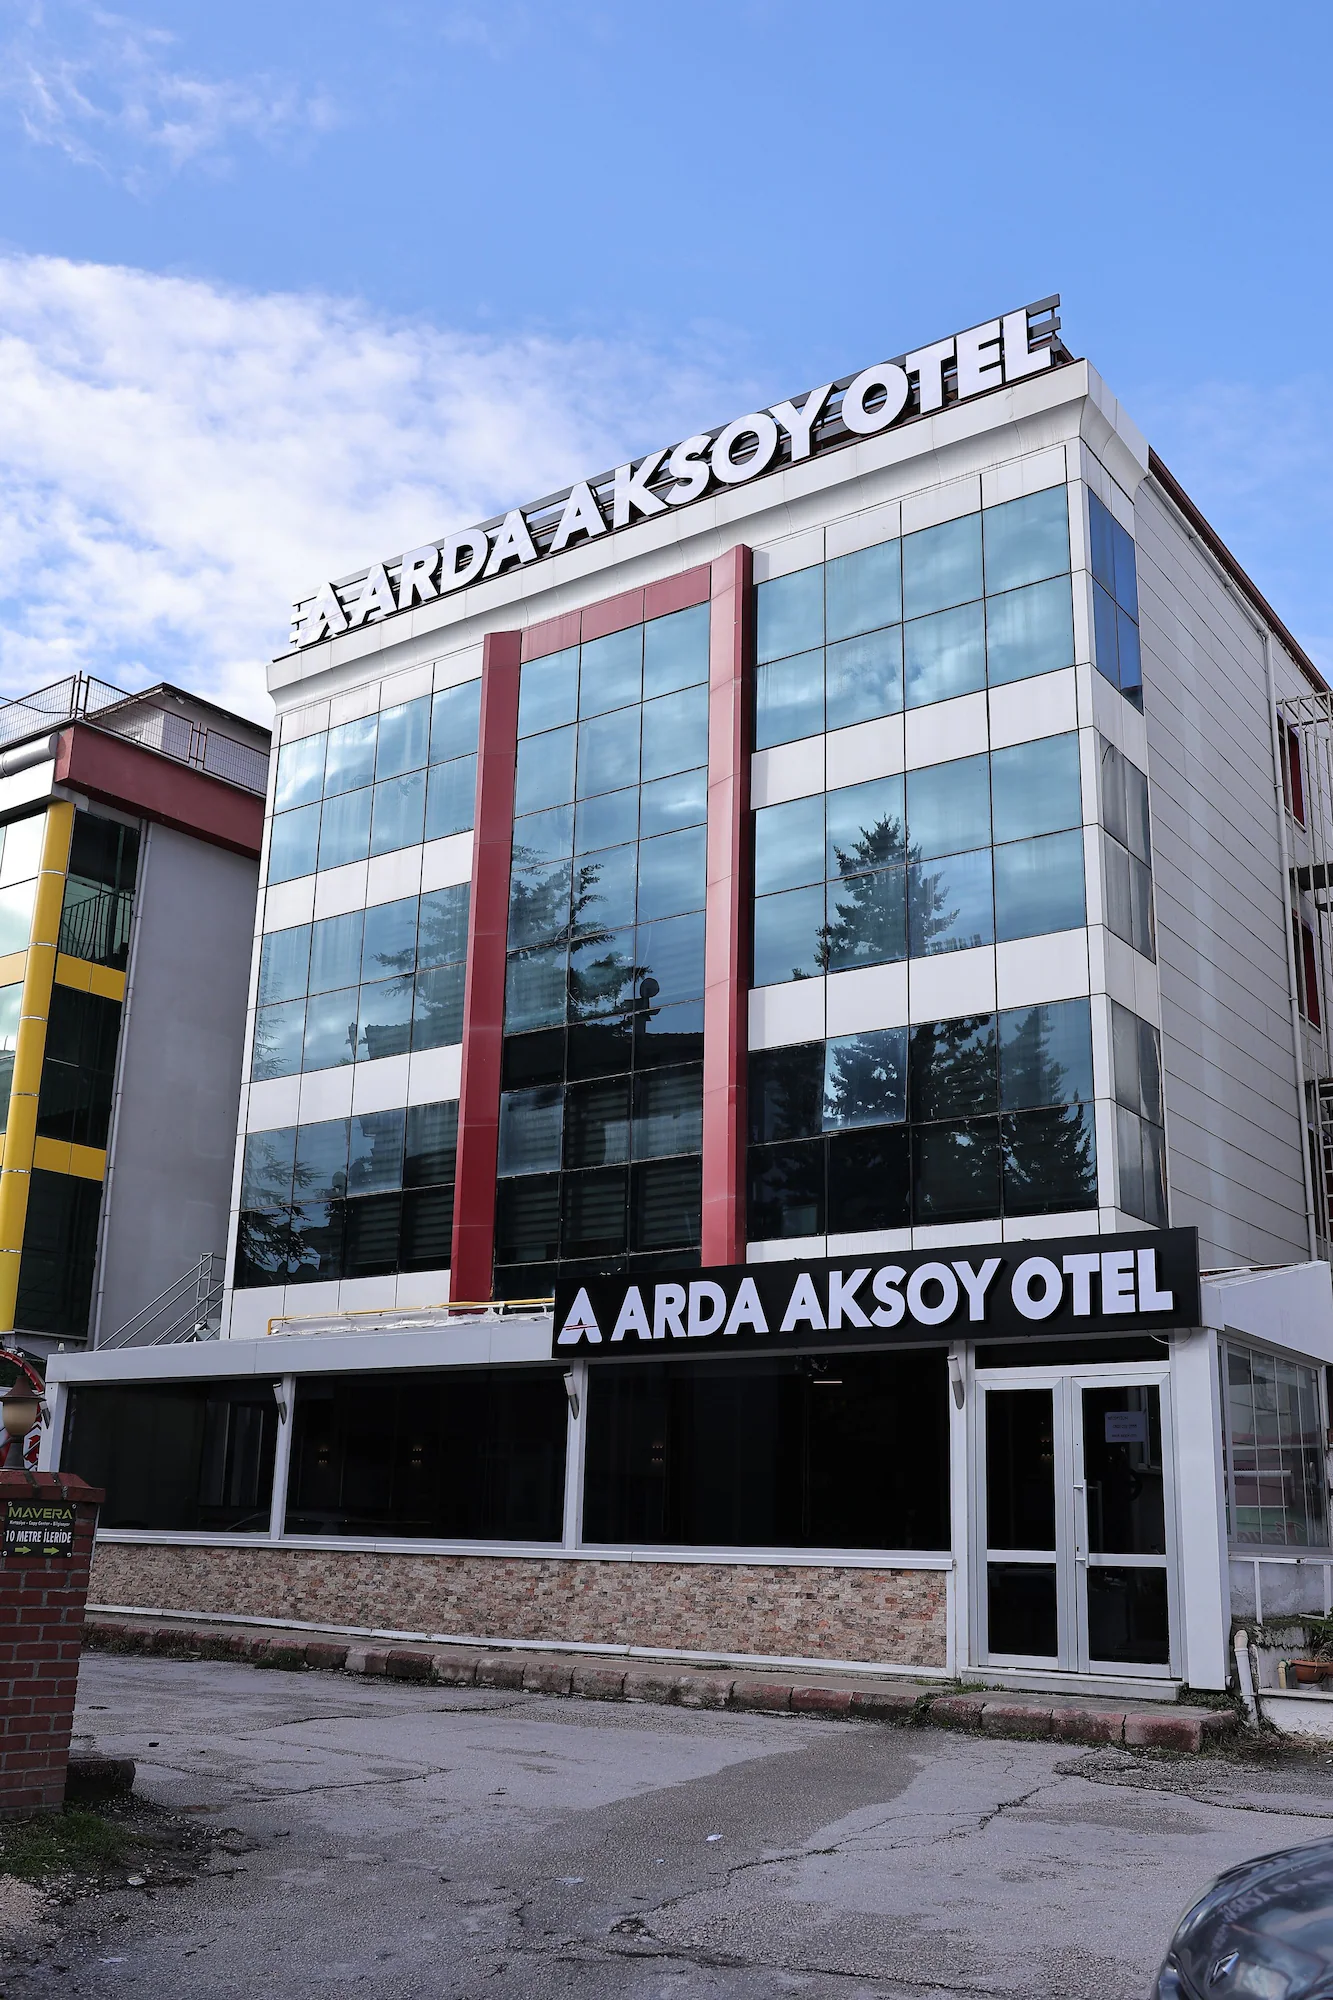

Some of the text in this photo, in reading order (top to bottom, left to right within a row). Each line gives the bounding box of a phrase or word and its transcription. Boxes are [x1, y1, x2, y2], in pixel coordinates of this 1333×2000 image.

[348, 509, 538, 628] ARDA
[549, 382, 834, 552] AKSOY
[842, 309, 1052, 434] OTEL
[610, 1277, 769, 1341] ARDA
[779, 1257, 1002, 1332] AKSOY
[1011, 1248, 1174, 1320] OTEL
[6, 1528, 72, 1543] 10 METRE İLERİDE
[8, 1507, 73, 1519] MAVERA
